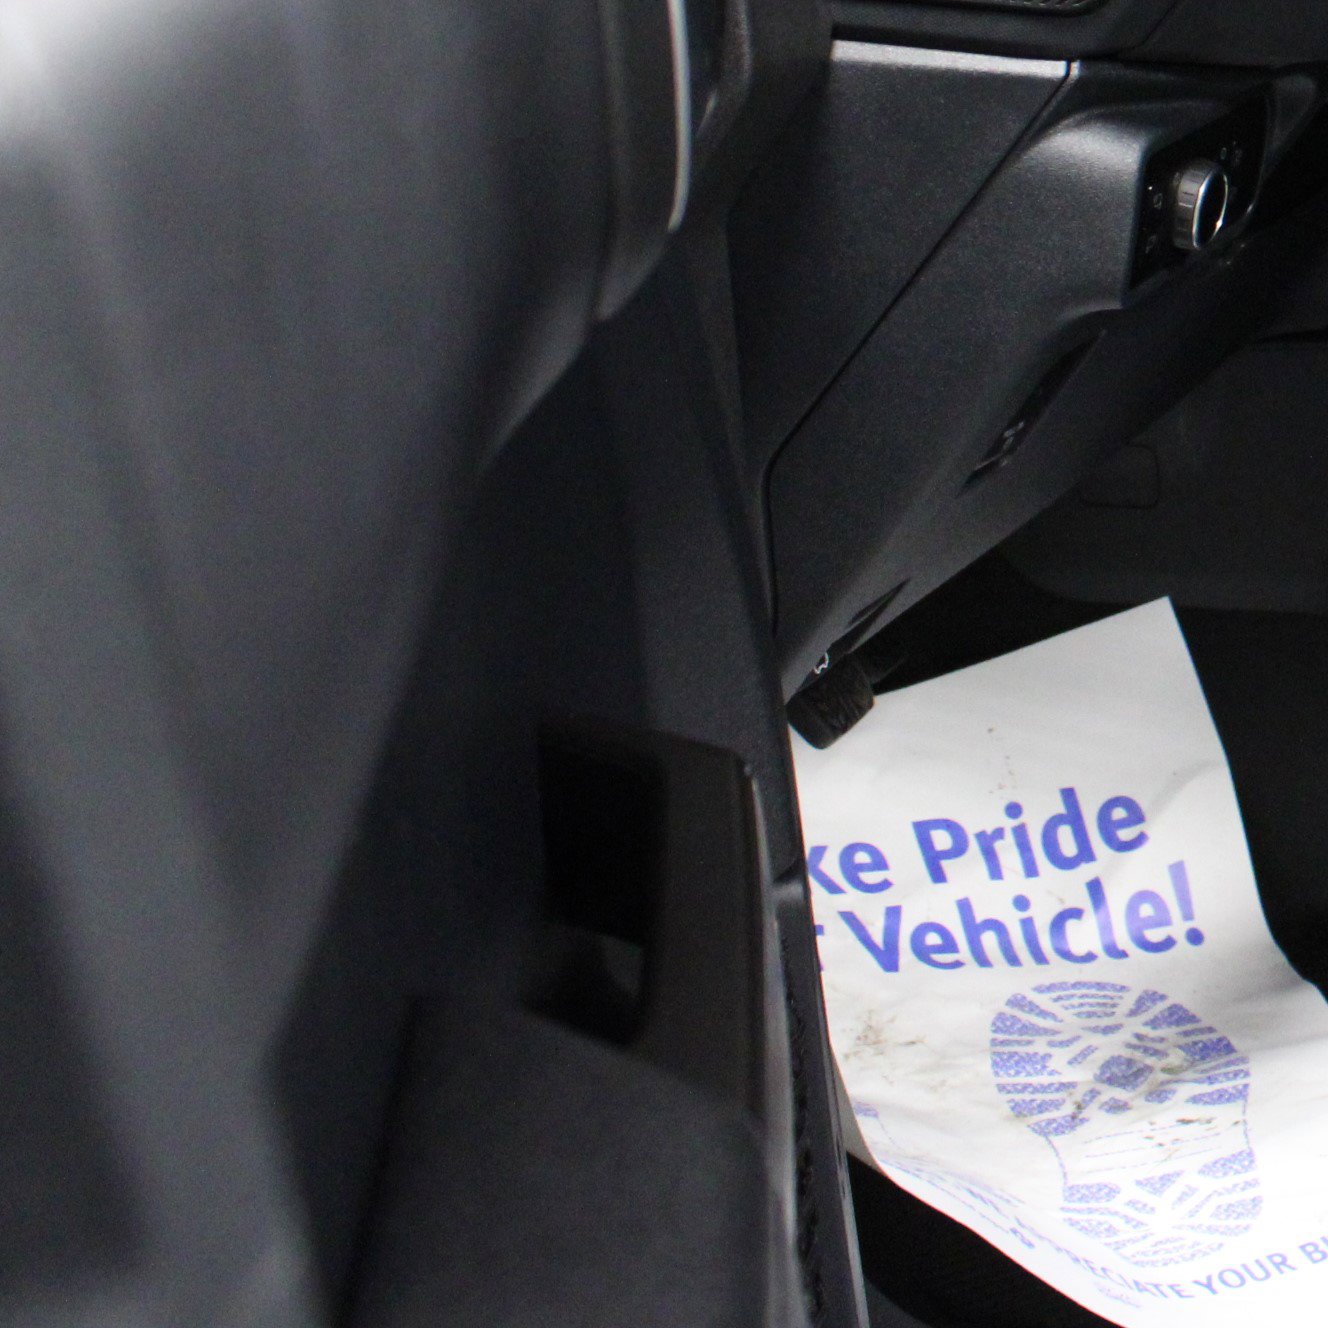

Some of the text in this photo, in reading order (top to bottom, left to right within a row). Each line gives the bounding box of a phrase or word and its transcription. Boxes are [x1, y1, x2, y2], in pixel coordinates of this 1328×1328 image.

[913, 787, 1149, 884] Pride
[838, 861, 1205, 972] Vehicle!
[1193, 1252, 1297, 1296] YOUR
